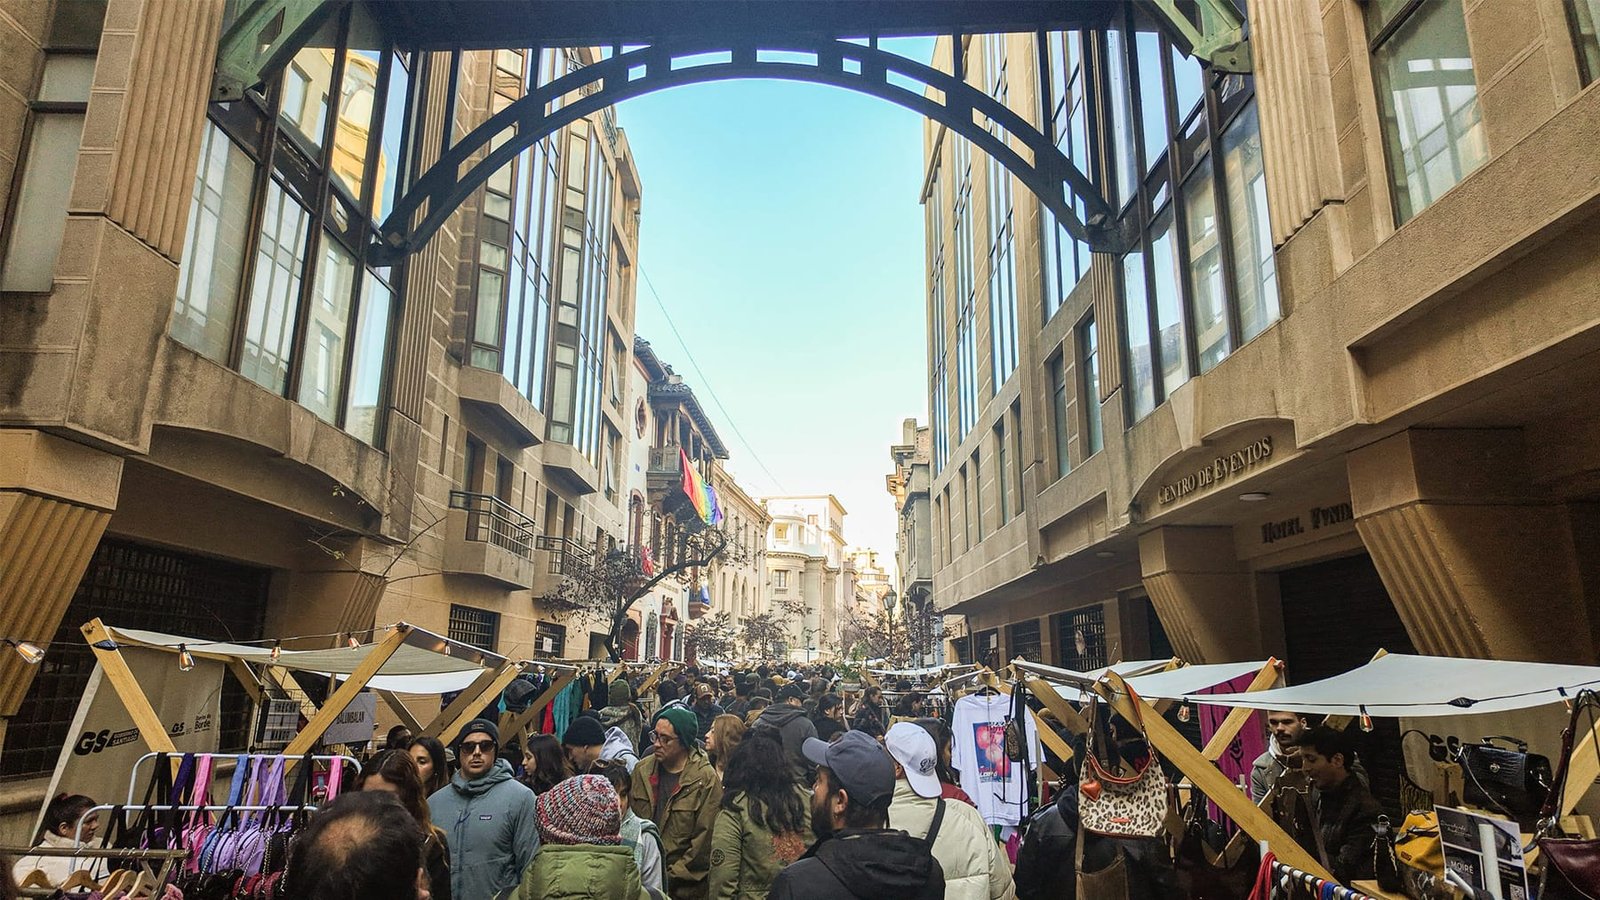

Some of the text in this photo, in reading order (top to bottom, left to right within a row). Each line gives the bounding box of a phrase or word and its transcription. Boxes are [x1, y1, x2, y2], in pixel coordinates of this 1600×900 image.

[1158, 437, 1271, 505] CENTRO DE EVENTOS
[1261, 517, 1304, 544] HOTEL
[171, 721, 185, 733] GS
[73, 729, 110, 756] GS
[1450, 860, 1474, 875] MOIRÉ
